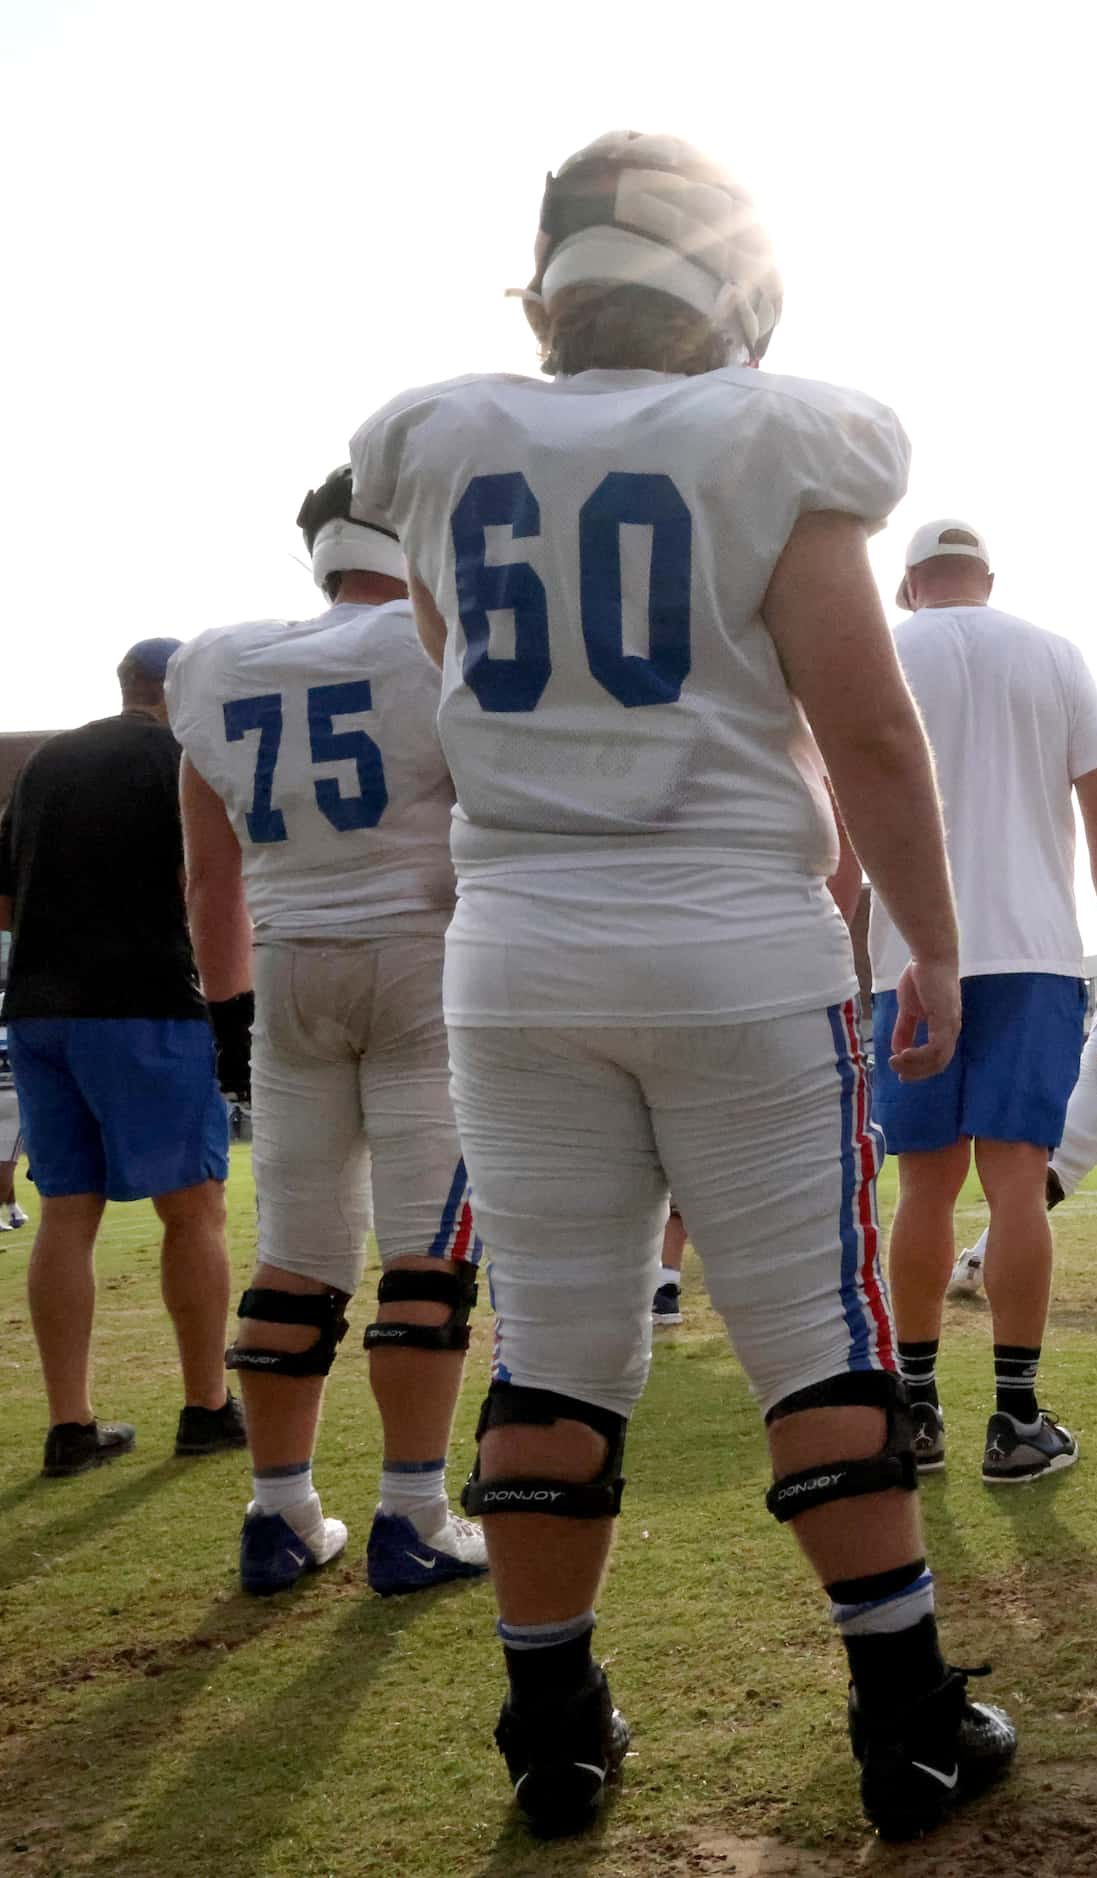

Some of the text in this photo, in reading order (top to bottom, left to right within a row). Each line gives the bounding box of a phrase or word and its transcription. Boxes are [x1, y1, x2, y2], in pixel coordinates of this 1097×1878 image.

[450, 472, 692, 713] 60
[222, 680, 389, 843] 75
[484, 1490, 561, 1502] DONJOY
[778, 1471, 845, 1501] DONJOY
